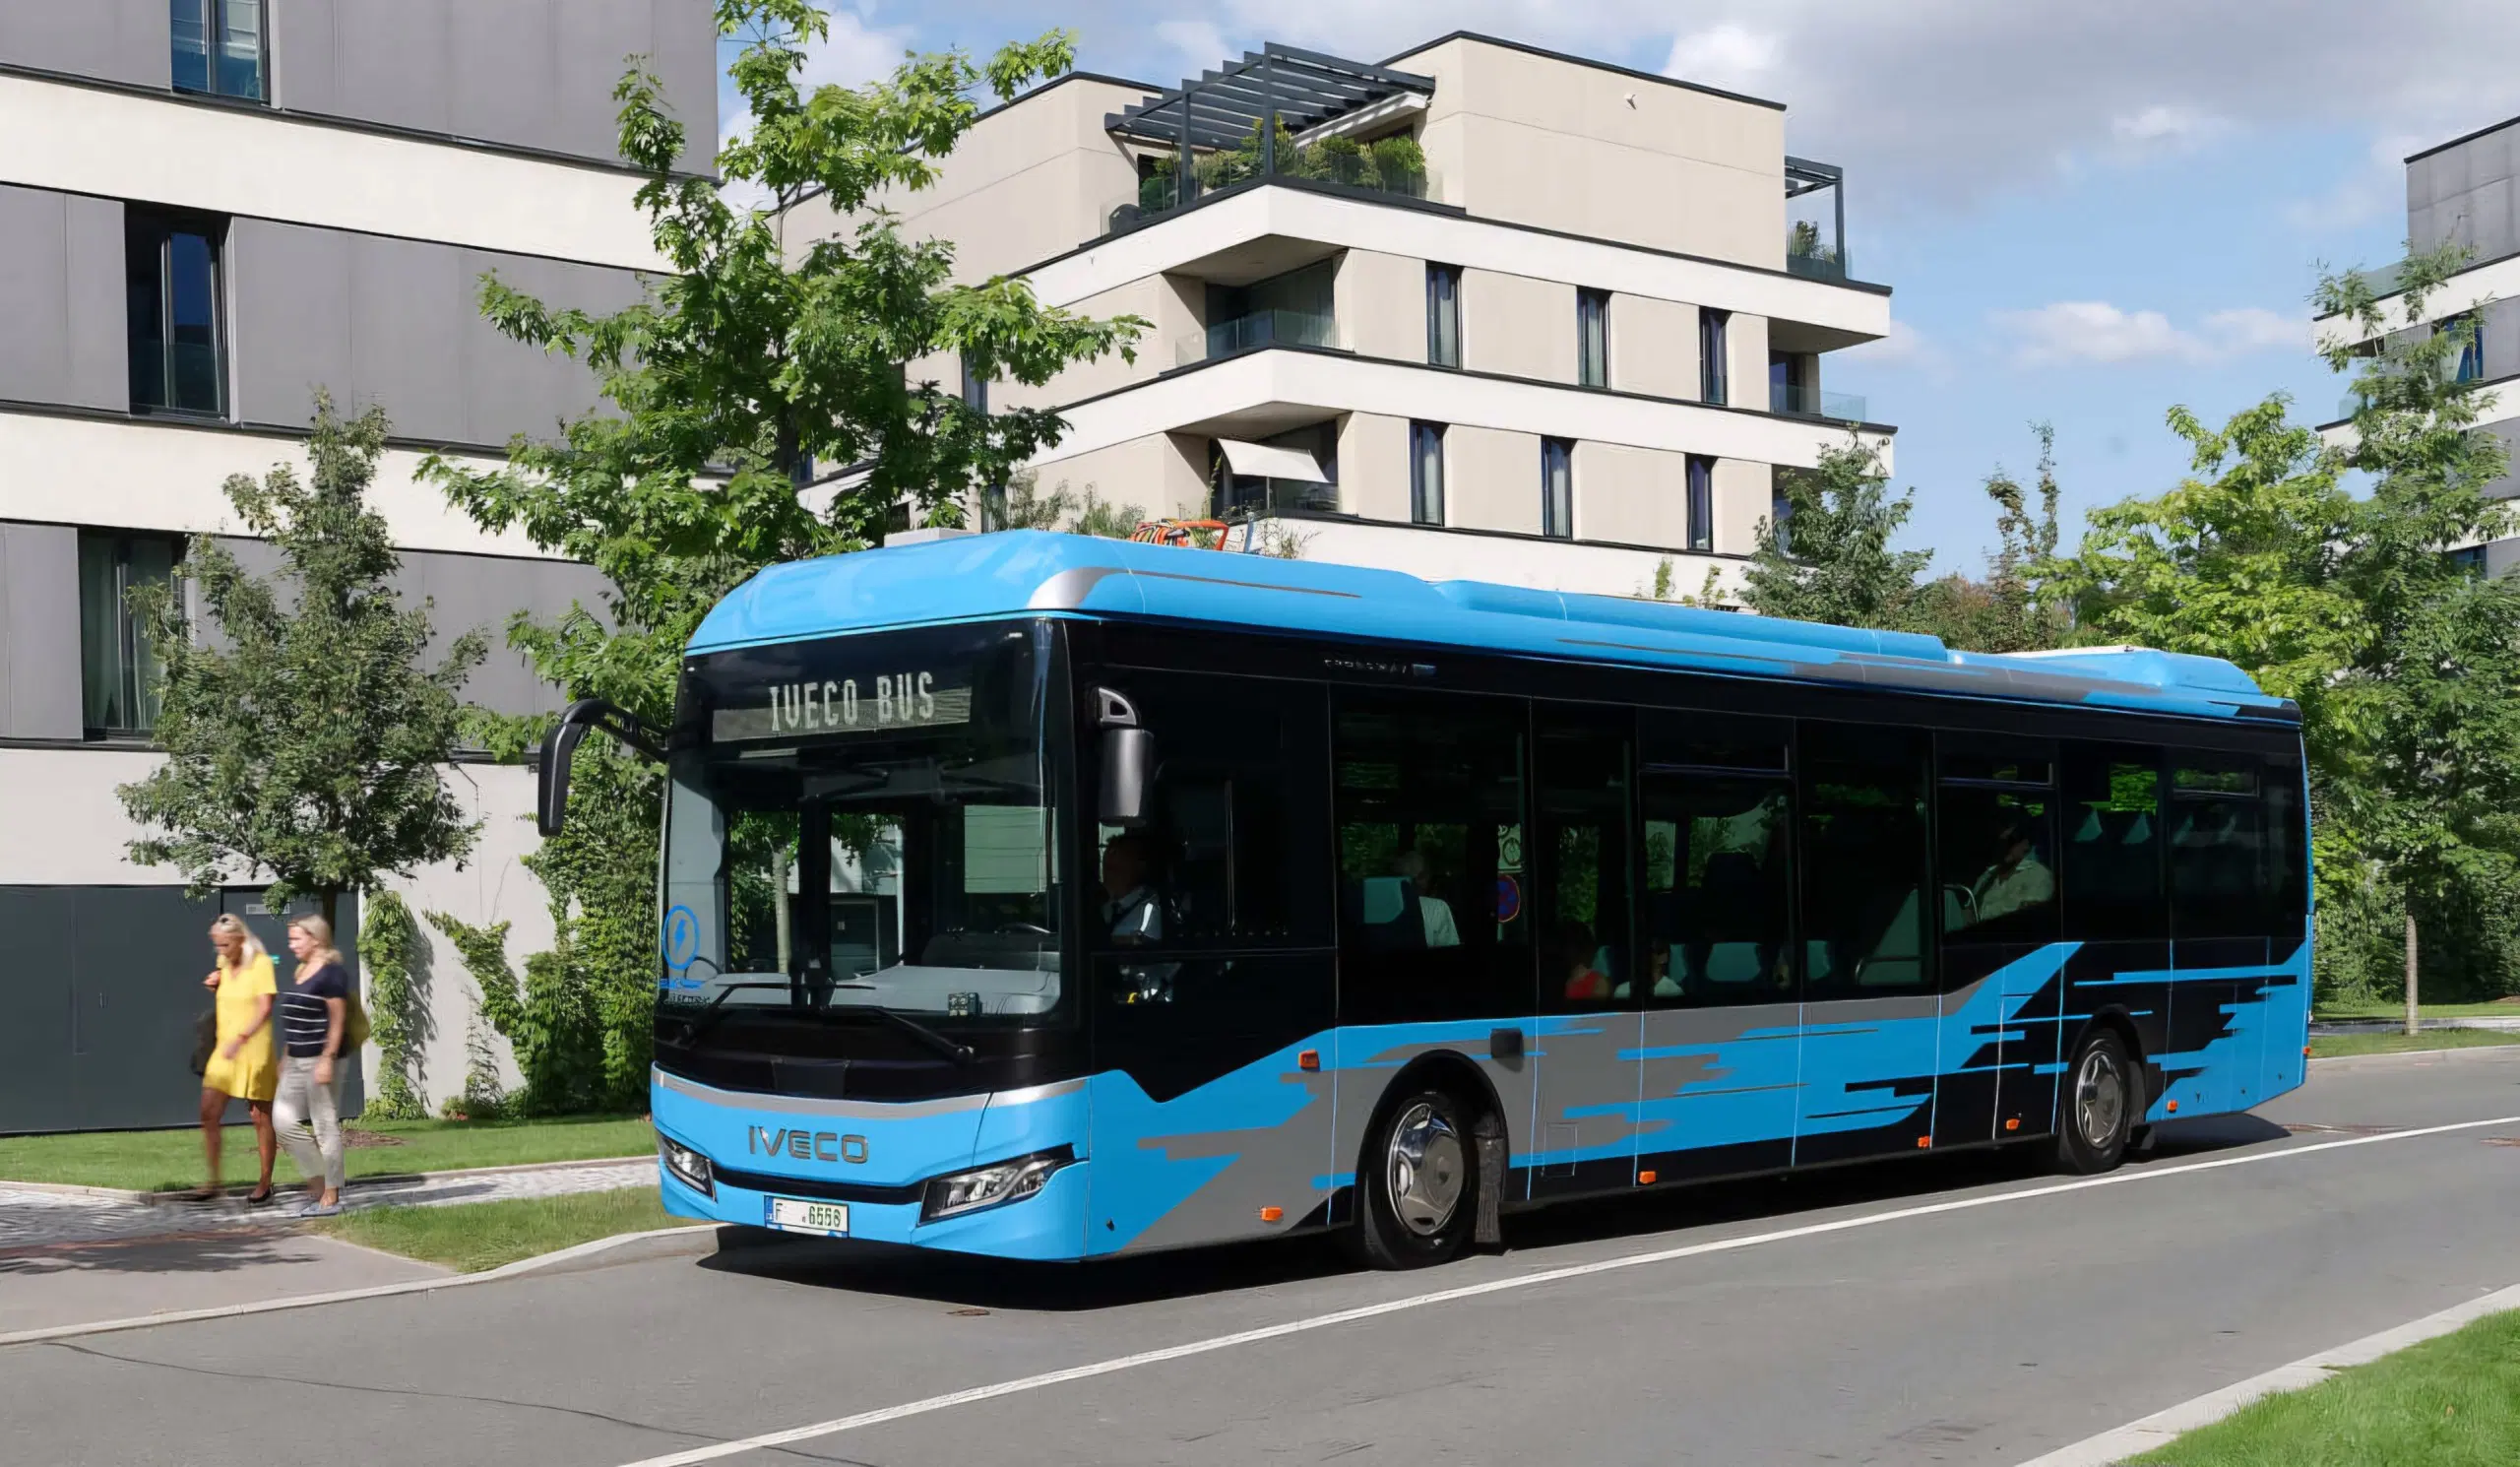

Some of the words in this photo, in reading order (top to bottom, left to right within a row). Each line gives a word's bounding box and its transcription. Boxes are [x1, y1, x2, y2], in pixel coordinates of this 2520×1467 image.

[768, 678, 858, 732] IVECO
[876, 671, 934, 724] BUS
[748, 1125, 869, 1165] IVECO
